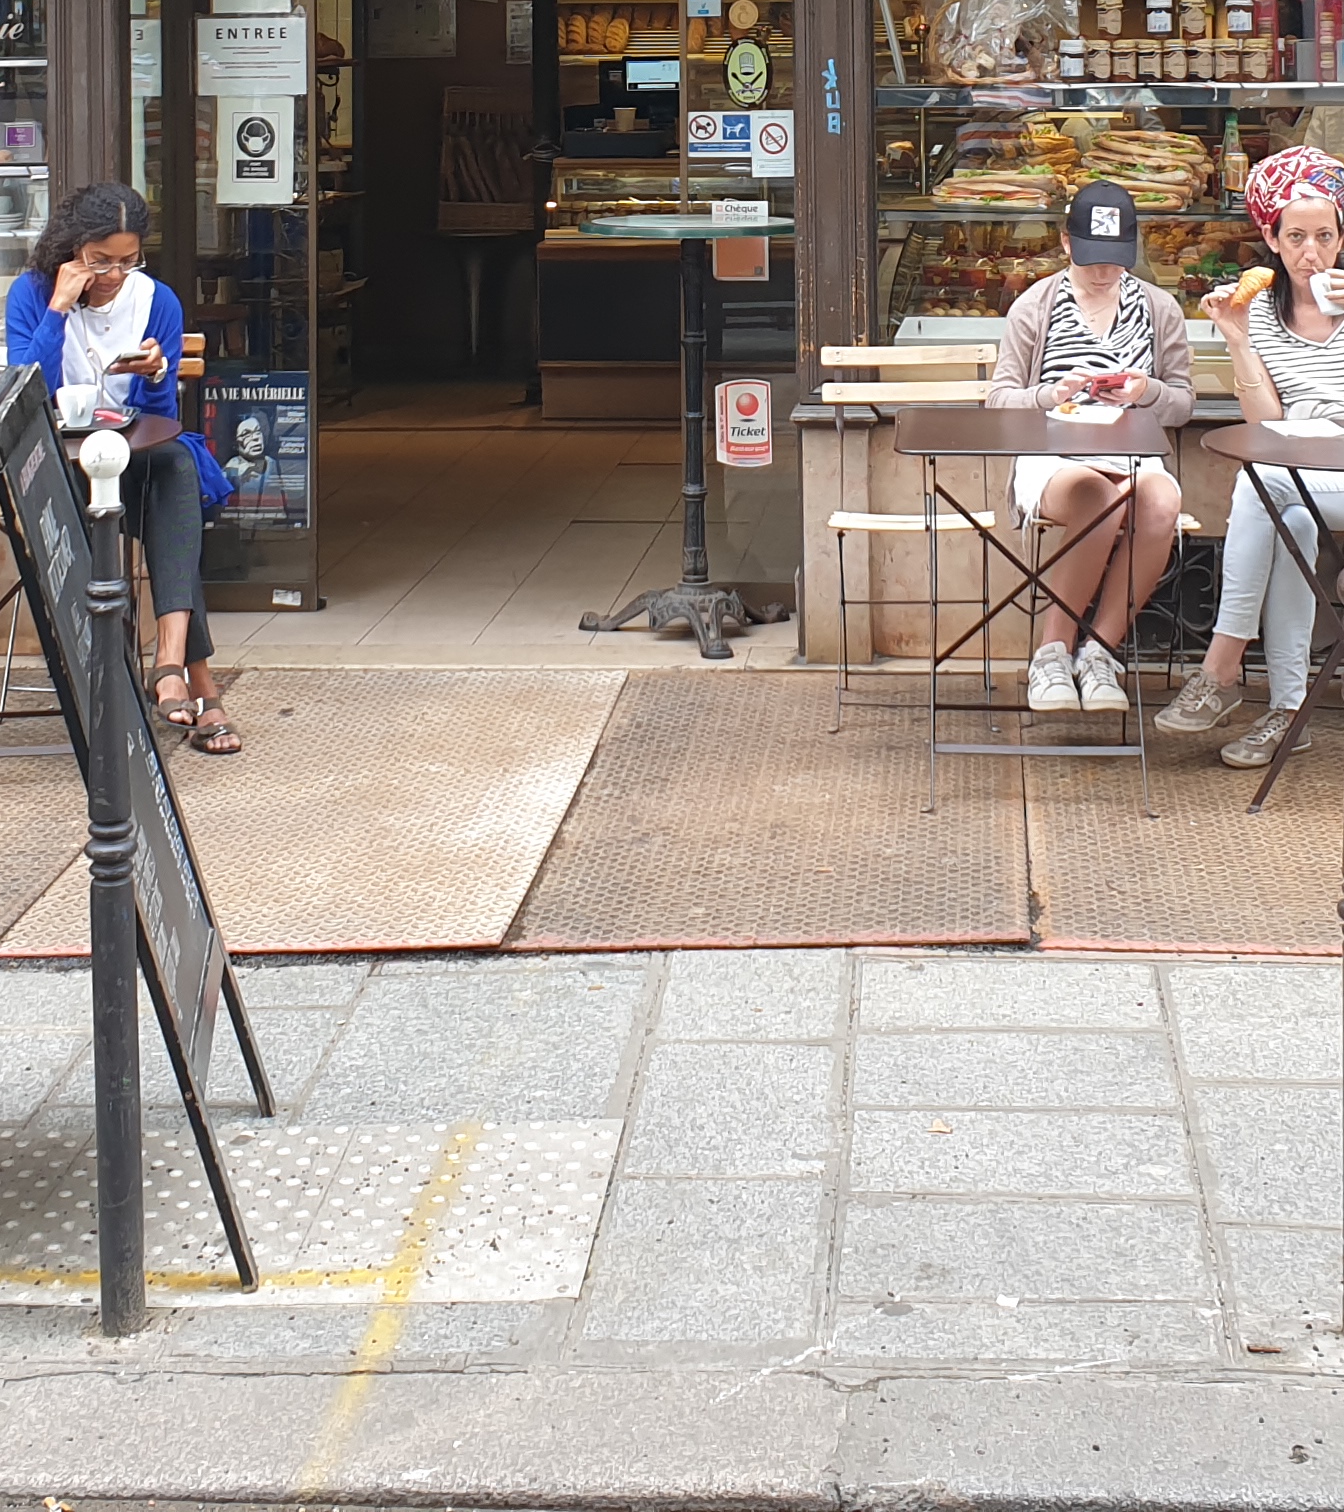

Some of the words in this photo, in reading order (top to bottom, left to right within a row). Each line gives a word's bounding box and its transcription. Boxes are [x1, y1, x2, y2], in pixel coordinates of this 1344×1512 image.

[216, 26, 288, 40] ENTREE
[725, 204, 759, 213] Chèque
[204, 387, 218, 401] LA
[222, 387, 240, 401] VIE
[242, 384, 306, 401] MATÉRIELLE
[730, 426, 767, 437] Ticket
